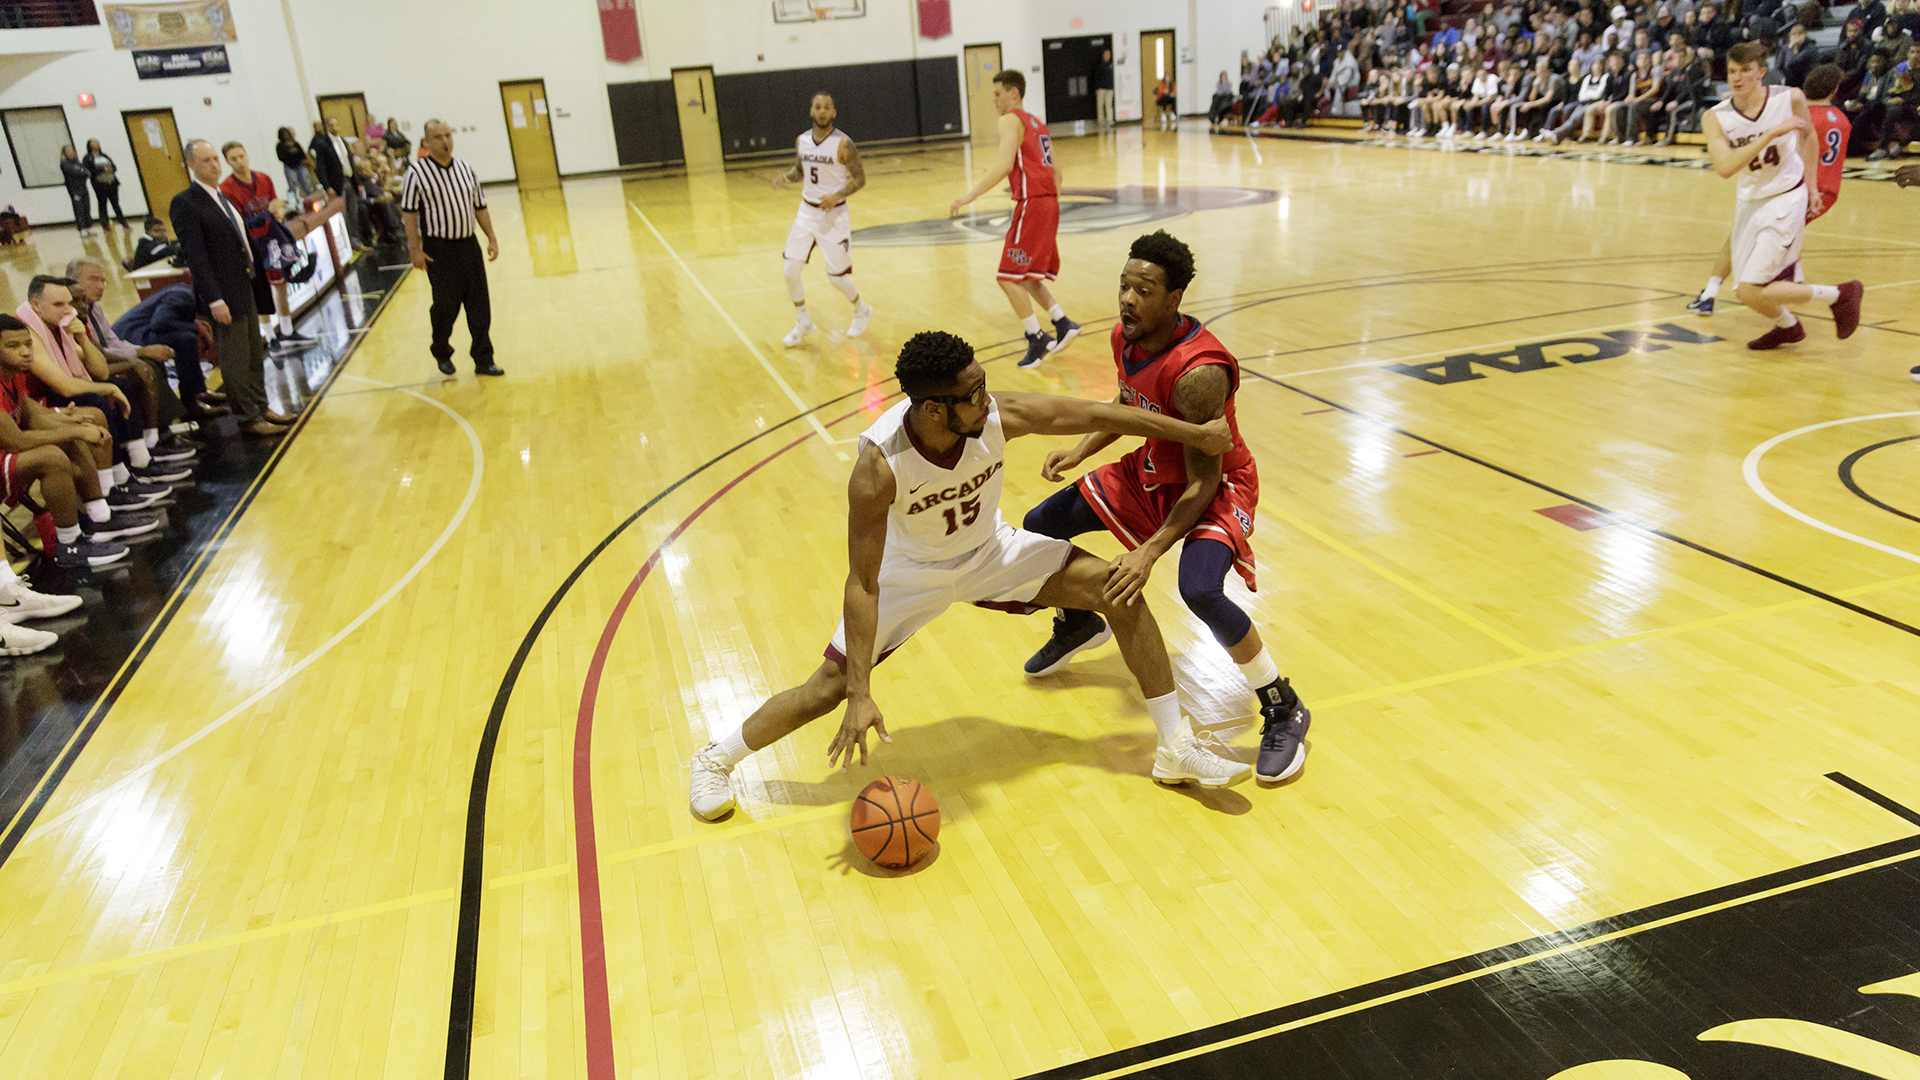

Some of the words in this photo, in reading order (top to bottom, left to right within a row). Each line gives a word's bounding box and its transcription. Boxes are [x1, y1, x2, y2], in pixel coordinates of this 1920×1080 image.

[800, 153, 834, 165] RCADIA
[1820, 128, 1841, 166] 3
[810, 166, 818, 184] 5
[1379, 323, 1726, 385] NCAA
[906, 460, 1004, 515] ARCADIA
[941, 492, 981, 537] 15
